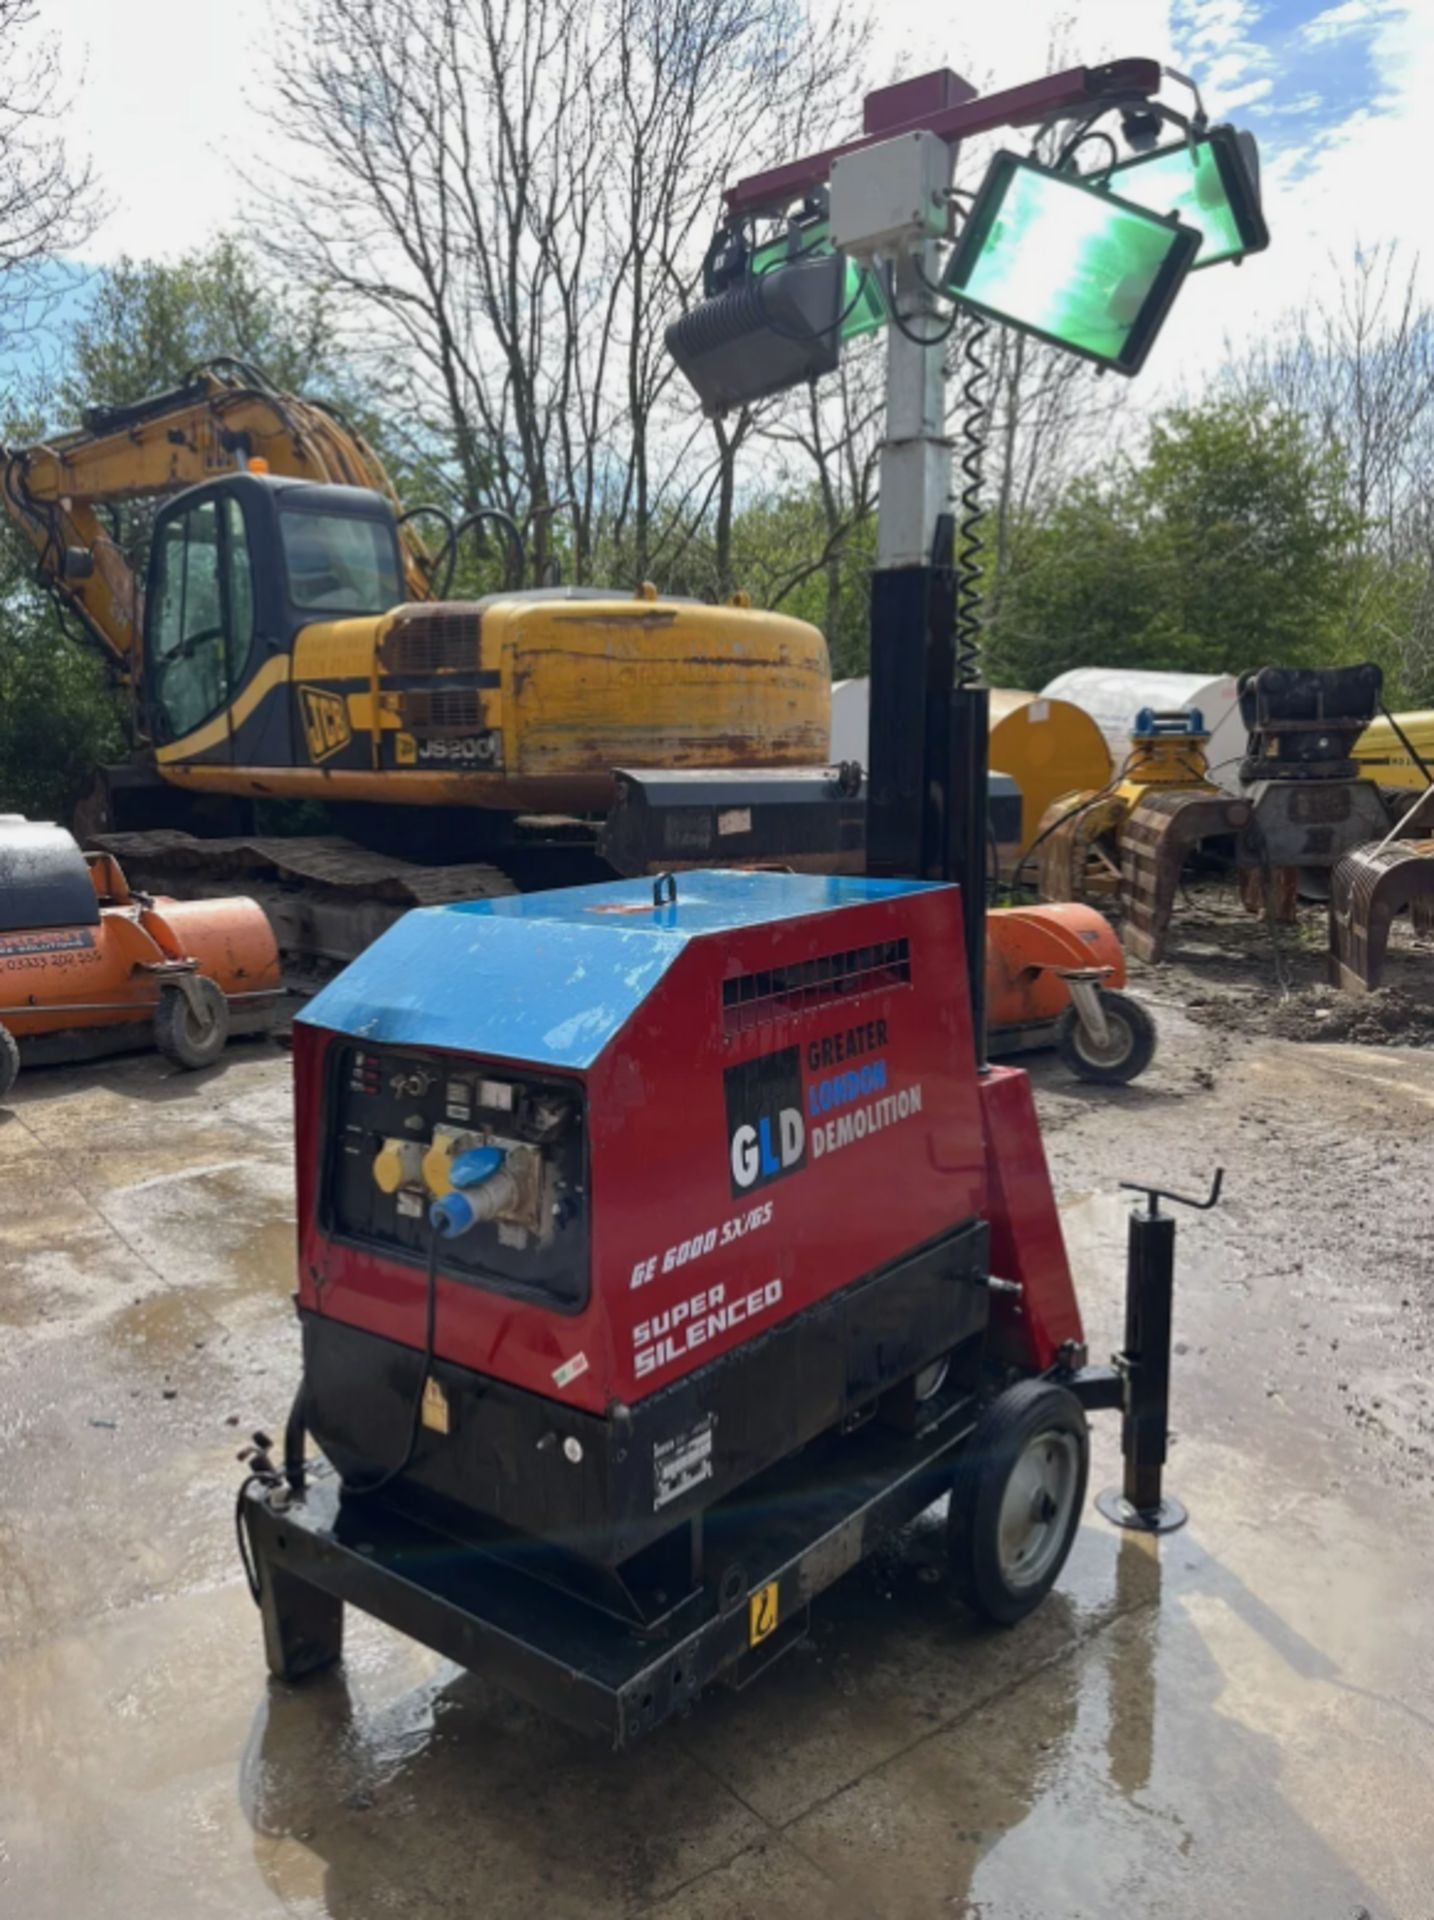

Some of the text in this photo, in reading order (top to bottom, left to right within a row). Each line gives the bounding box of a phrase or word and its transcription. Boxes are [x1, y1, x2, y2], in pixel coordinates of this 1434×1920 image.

[304, 692, 348, 756] JCB
[807, 1019, 888, 1071] GREATER
[808, 1059, 886, 1117] LONDON
[731, 1107, 805, 1187] GLD
[812, 1083, 922, 1159] DEMOLITION
[630, 1256, 657, 1290] GE
[661, 1228, 717, 1274] 6000
[633, 1283, 725, 1348] SUPER
[634, 1278, 783, 1379] SILENCED
